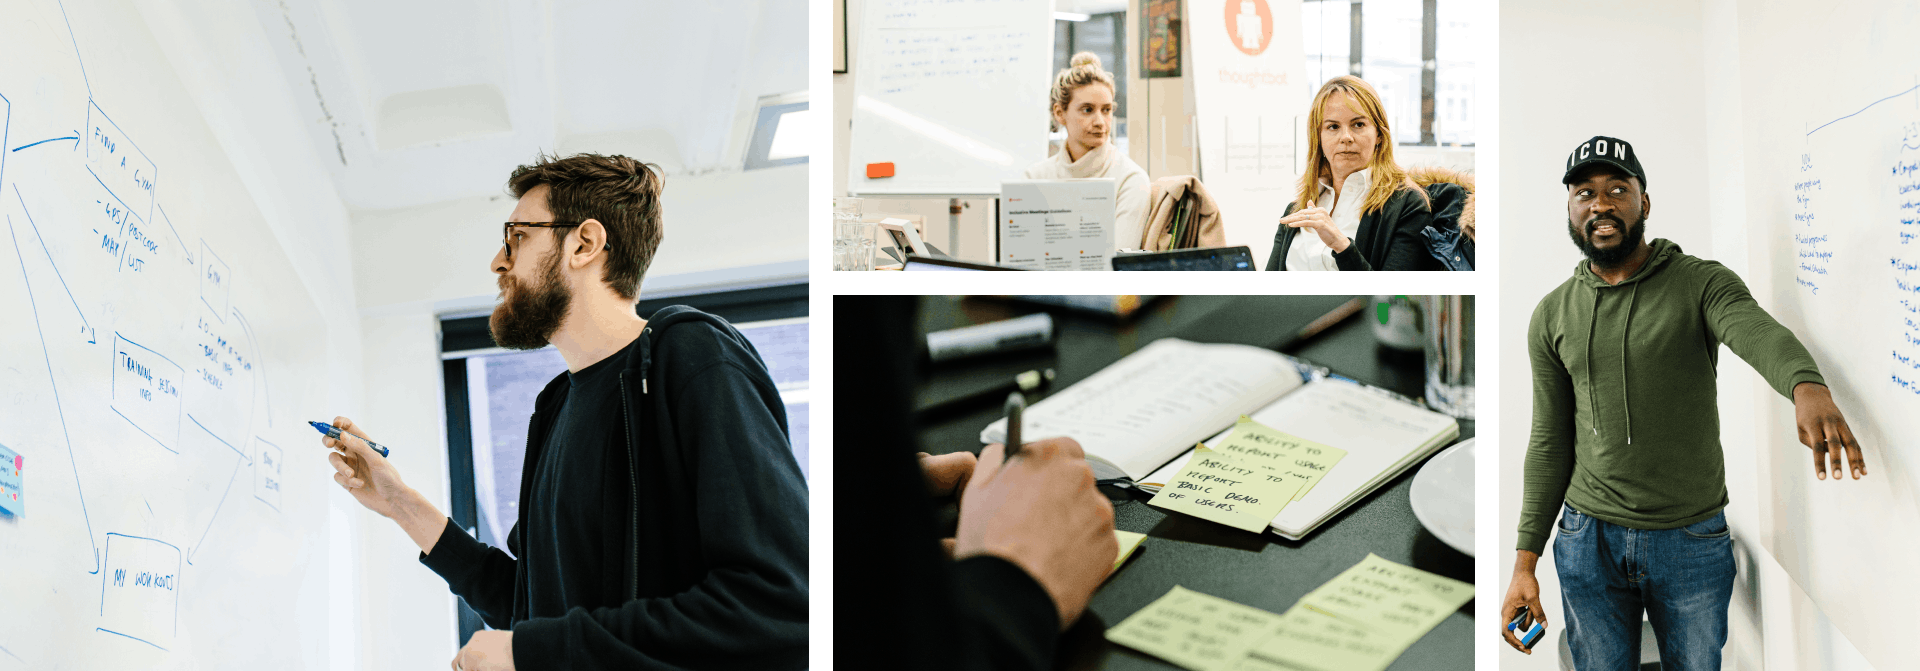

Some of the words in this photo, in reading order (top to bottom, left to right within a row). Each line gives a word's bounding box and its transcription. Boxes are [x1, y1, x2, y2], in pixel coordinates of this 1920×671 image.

[95, 126, 116, 154] FIND
[120, 155, 126, 170] A
[133, 169, 152, 197] GYM
[1571, 139, 1626, 166] ICON
[1227, 444, 1287, 459] REPORT
[1243, 432, 1300, 450] ABILITY
[1305, 447, 1322, 456] TO
[1187, 470, 1243, 487] REPORT
[1198, 458, 1255, 477] ABILITY
[1266, 475, 1283, 483] TO
[1177, 480, 1213, 494] BASIC
[113, 568, 127, 588] MY
